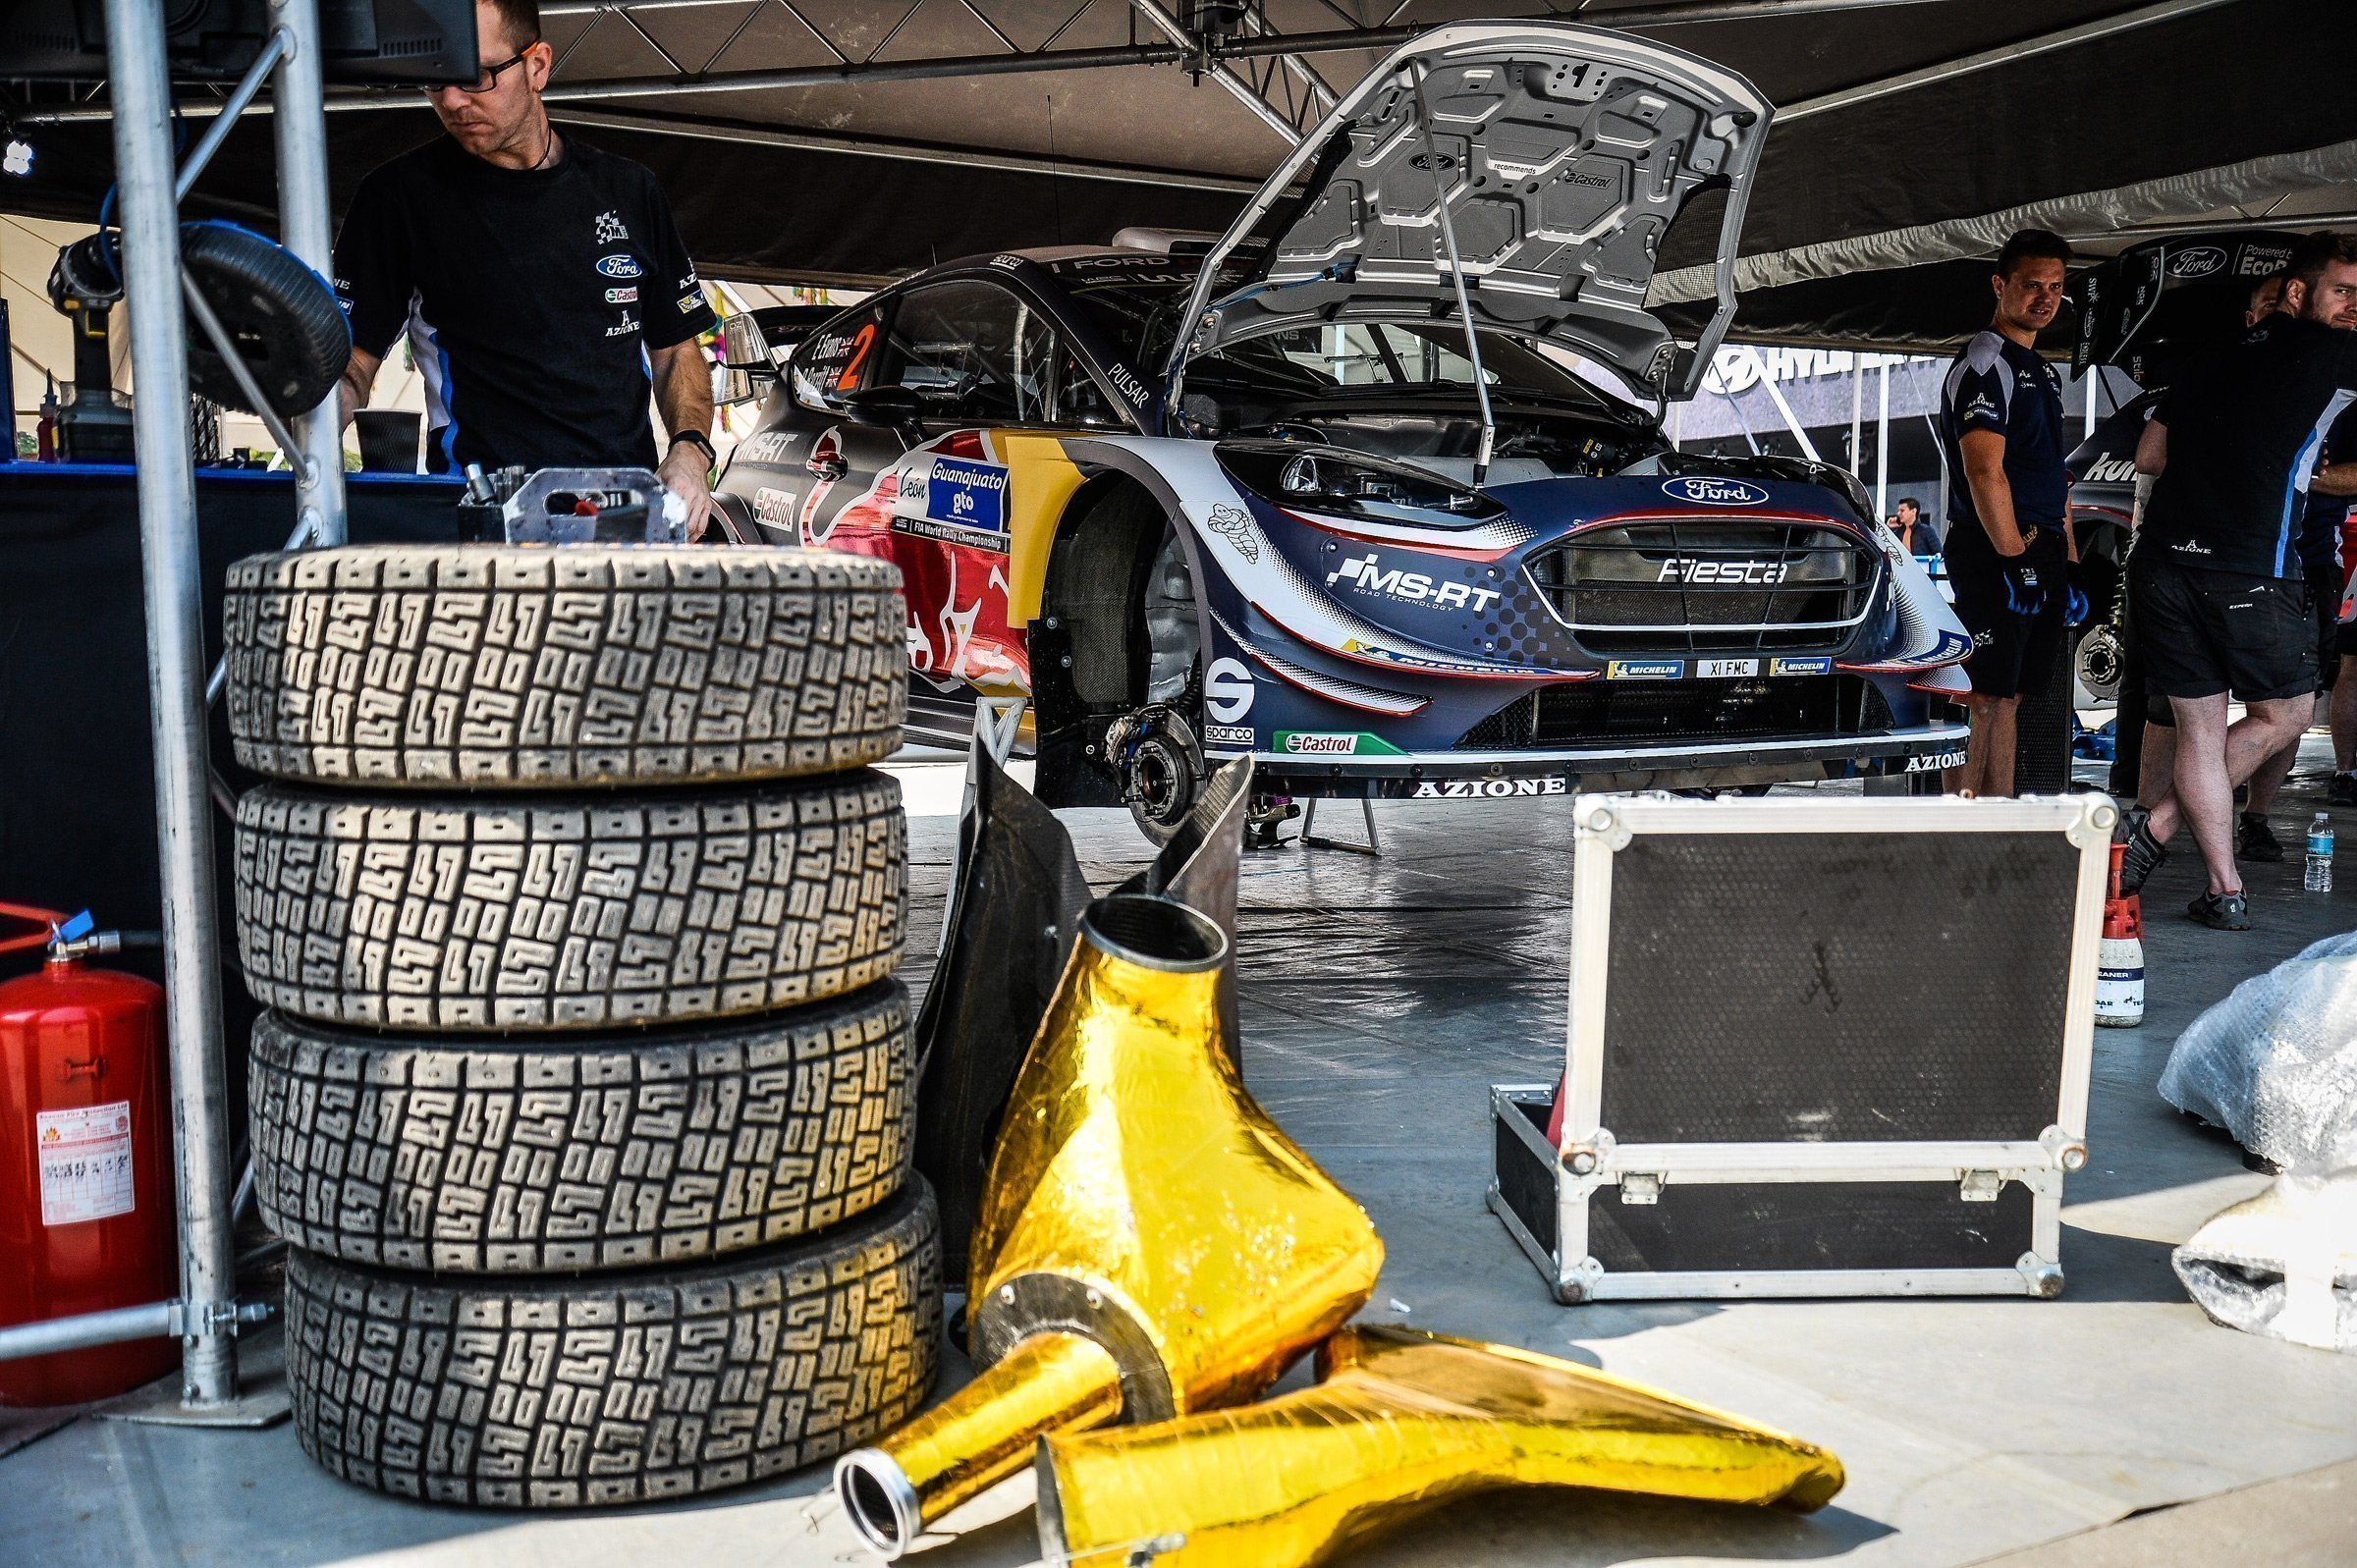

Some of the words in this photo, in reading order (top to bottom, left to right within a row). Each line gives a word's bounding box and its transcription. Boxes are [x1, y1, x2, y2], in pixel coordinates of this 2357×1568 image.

[1494, 163, 1536, 175] recommends
[1574, 174, 1613, 188] Castrol
[1073, 257, 1170, 269] FORD
[2172, 249, 2218, 274] Ford
[2245, 244, 2287, 257] Powered
[2285, 249, 2293, 260] t
[605, 321, 640, 337] AZIONE
[837, 324, 875, 391] 2
[2132, 355, 2144, 382] Stilo
[1107, 362, 1149, 409] PULSAR
[900, 467, 926, 499] León
[932, 461, 1002, 491] Guanajuato
[1684, 479, 1751, 501] Ford
[760, 493, 796, 526] Castrol
[953, 491, 974, 514] gto
[914, 522, 924, 533] FIA
[925, 524, 942, 537] World
[942, 528, 958, 542] Rally
[958, 531, 1001, 550] Championship
[1657, 559, 1788, 584] Fiesta
[1355, 564, 1501, 613] MS-RT
[1352, 588, 1381, 598] ROAD
[1386, 594, 1453, 613] TECHNOLOGY
[1629, 666, 1677, 675] MICHELIN
[1727, 661, 1749, 676] FMC
[1787, 662, 1826, 672] MICHELIN
[1206, 728, 1253, 741] sparco
[1301, 735, 1352, 752] Castrol
[1903, 750, 1966, 773] AZIONE
[1411, 778, 1566, 798] AZIONE
